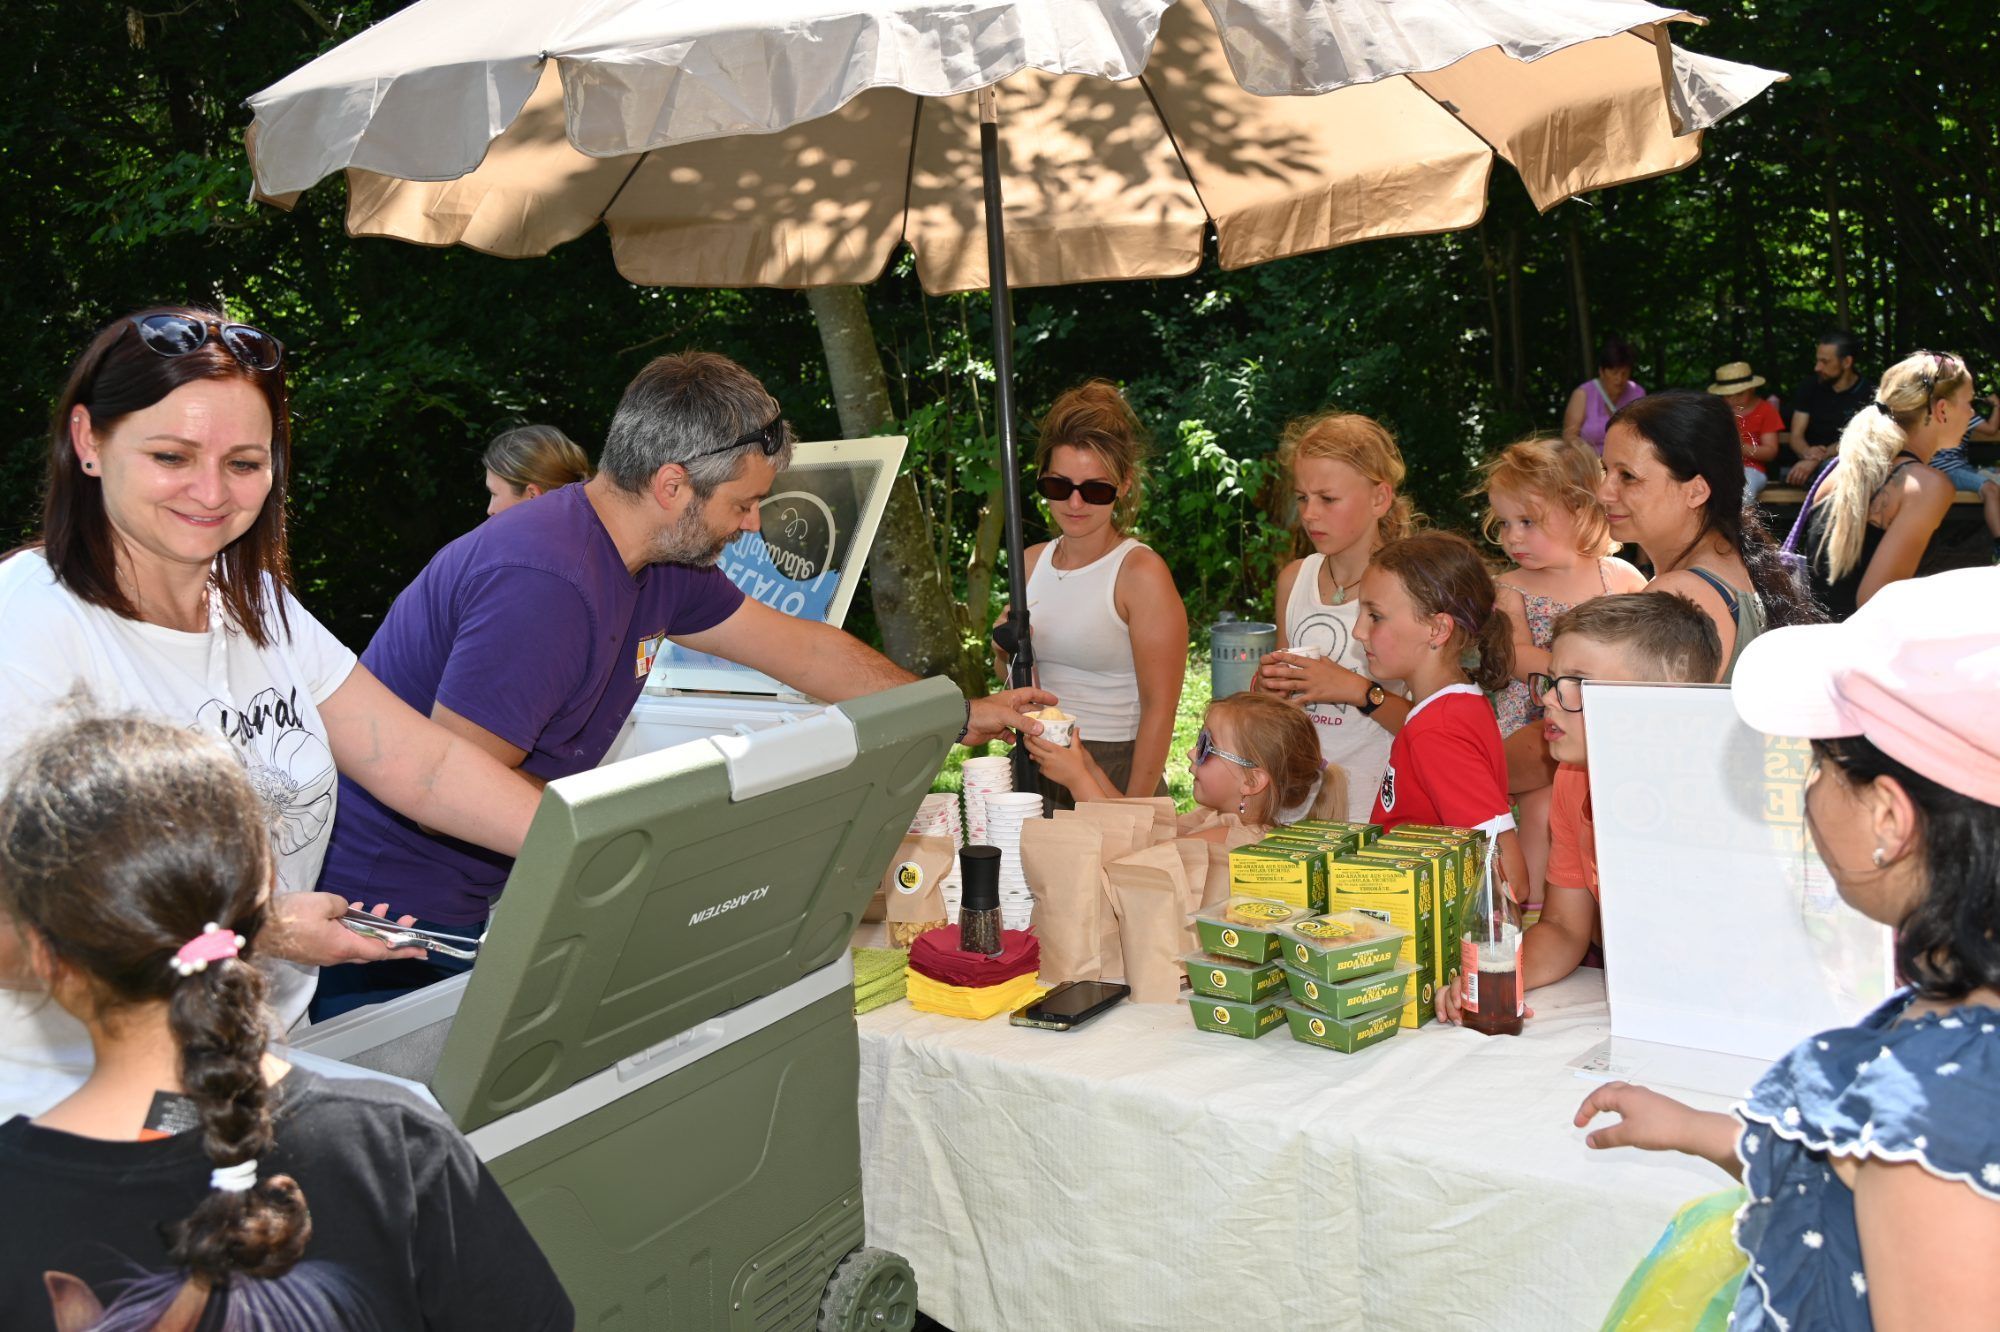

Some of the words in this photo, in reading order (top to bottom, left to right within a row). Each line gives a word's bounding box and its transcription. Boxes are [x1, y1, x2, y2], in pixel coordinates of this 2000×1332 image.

[688, 885, 770, 927] KLARSTEIN
[1336, 952, 1392, 970] BIOANANAS
[1346, 986, 1398, 1006] BIOANANAS
[1356, 1018, 1397, 1041] BIOANANAS
